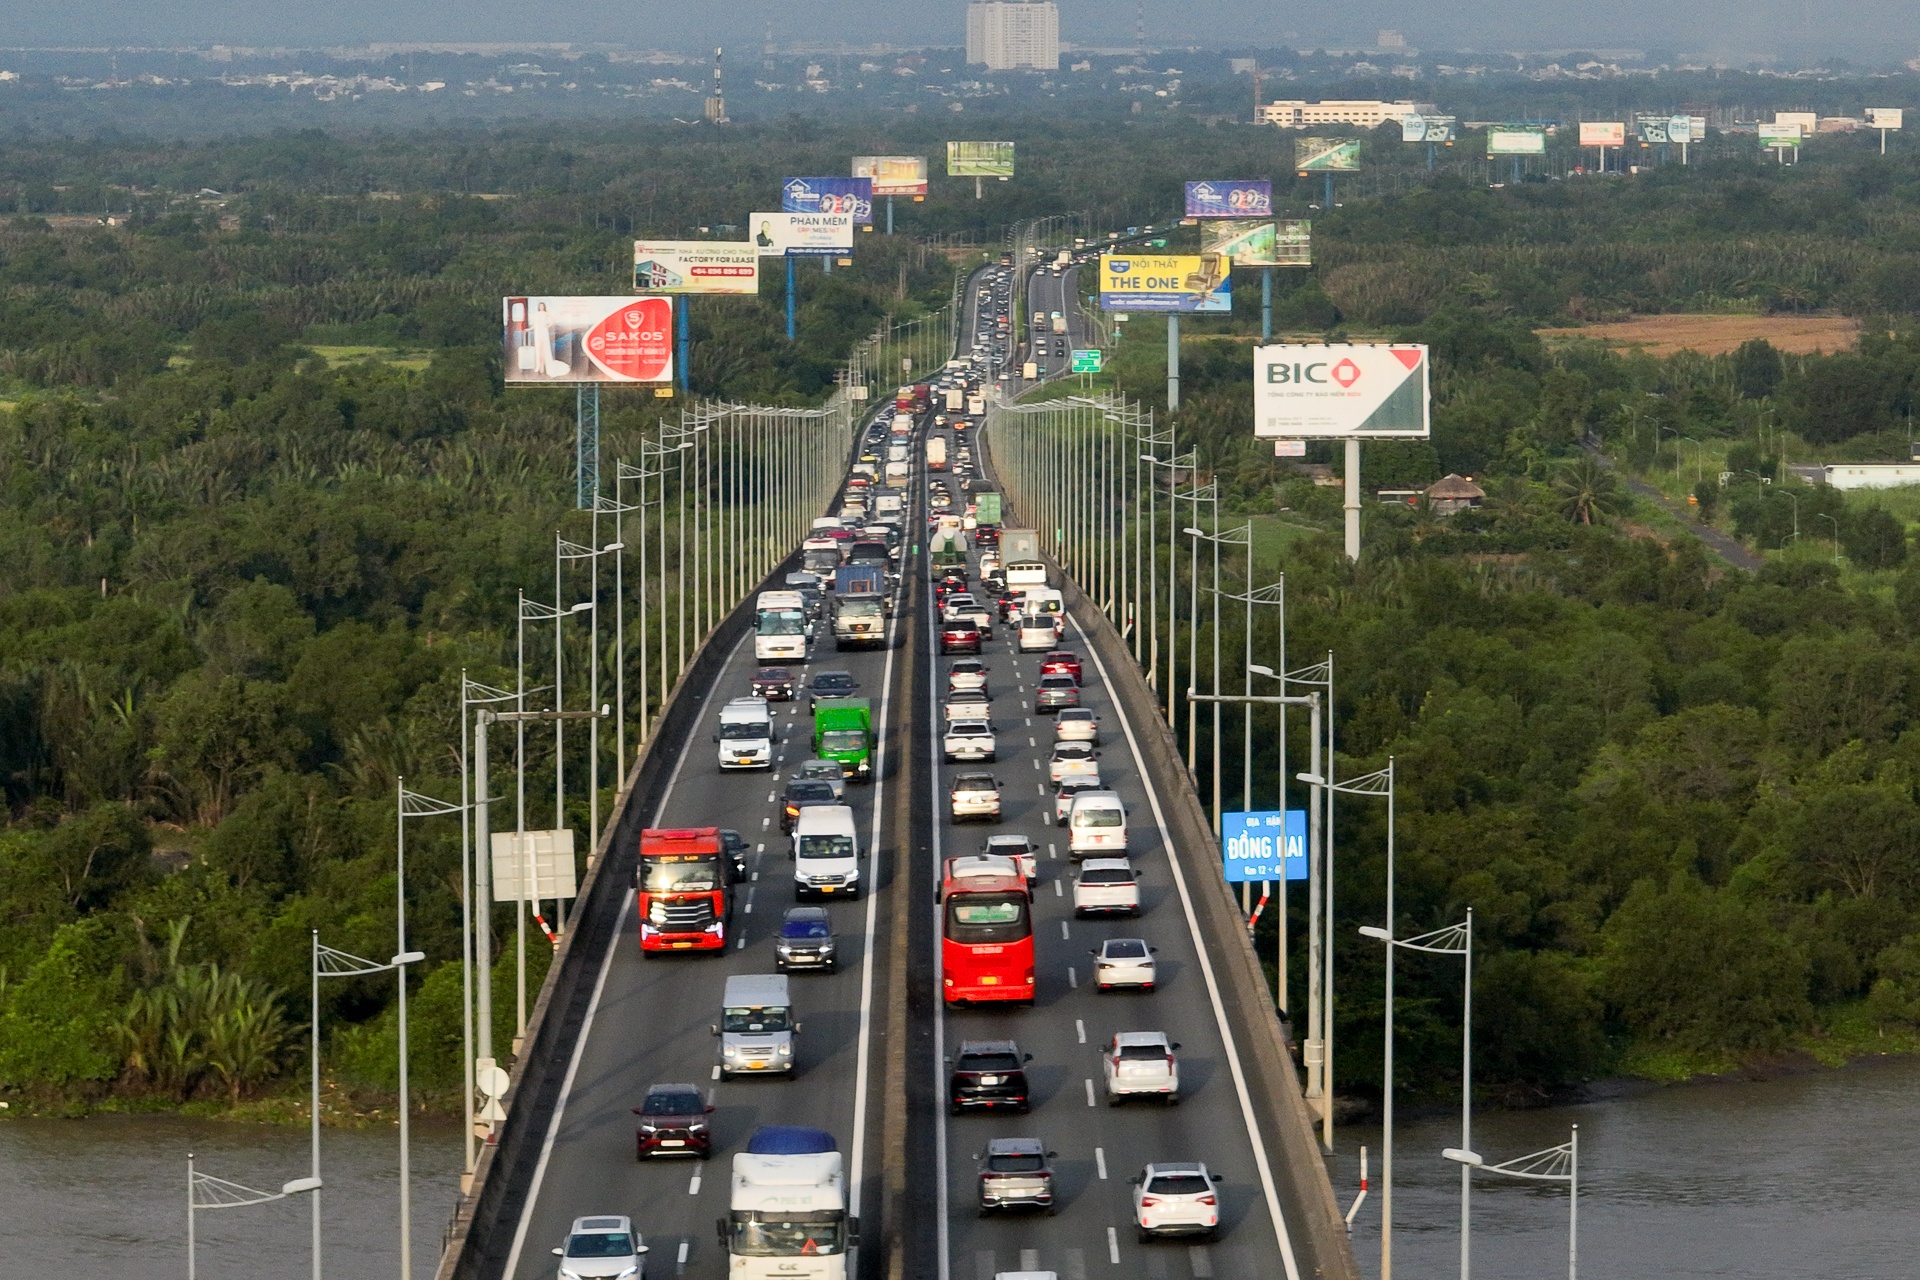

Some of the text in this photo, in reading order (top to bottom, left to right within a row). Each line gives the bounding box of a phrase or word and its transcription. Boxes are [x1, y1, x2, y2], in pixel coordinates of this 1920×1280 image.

[1110, 277, 1179, 289] THE ONE
[605, 332, 664, 341] SAKOS
[1267, 363, 1327, 383] BIC
[1227, 829, 1272, 859] ĐỒNG
[1258, 865, 1266, 874] 12
